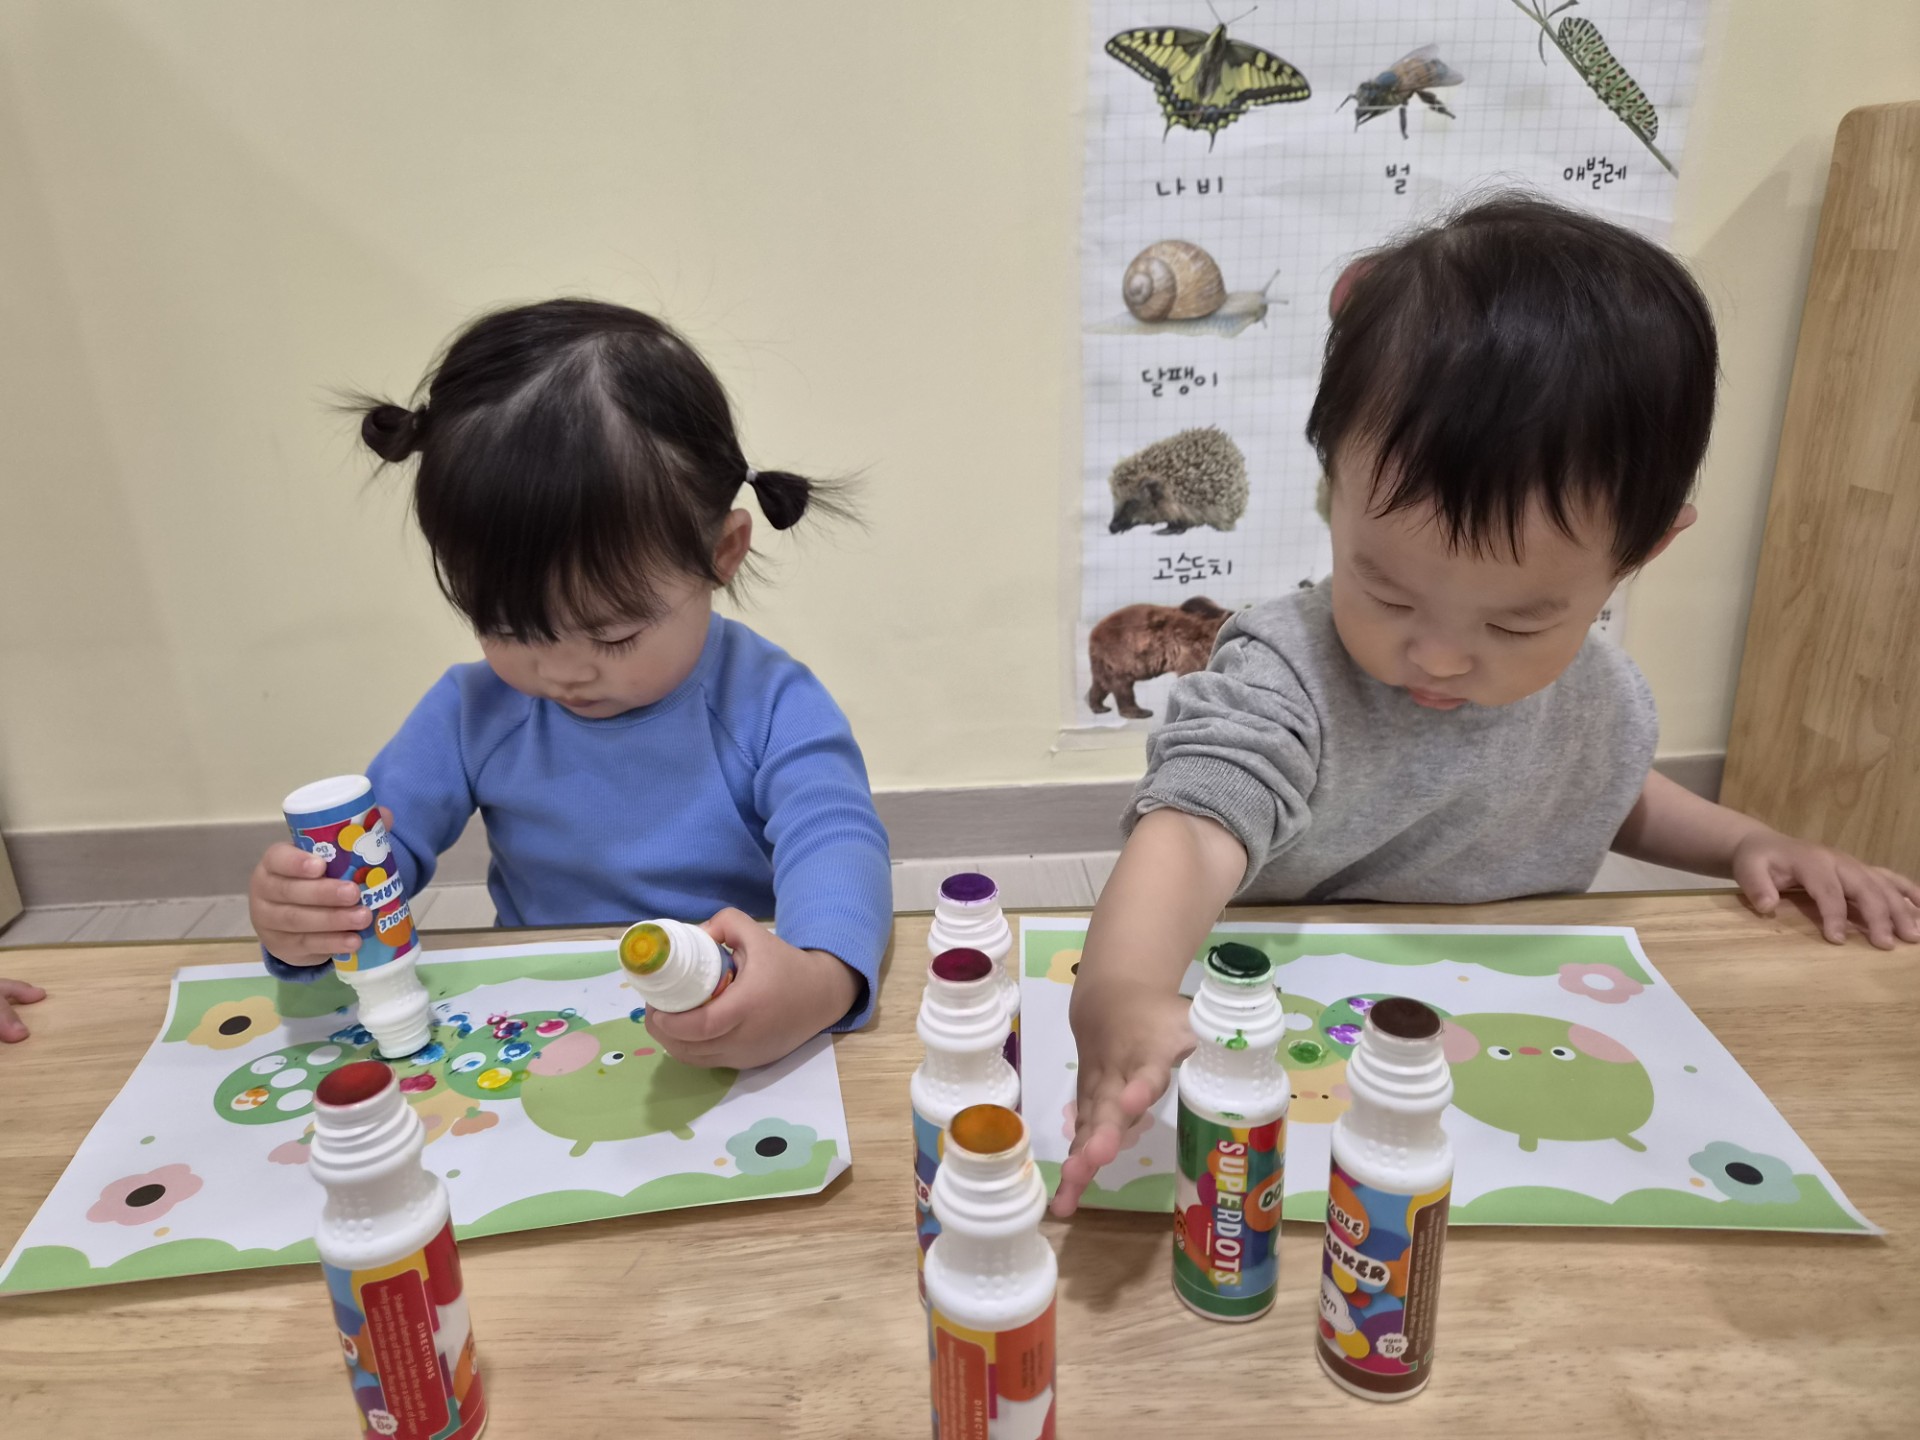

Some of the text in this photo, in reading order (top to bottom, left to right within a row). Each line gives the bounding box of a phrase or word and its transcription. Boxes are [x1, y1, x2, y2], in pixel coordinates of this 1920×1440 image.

[1156, 176, 1223, 196] 나비
[1386, 163, 1411, 195] 벌
[1563, 156, 1626, 190] 애벌레
[1141, 366, 1218, 397] 달팽이
[1152, 552, 1231, 584] 고슴도치
[363, 876, 403, 907] ARKE
[1260, 1183, 1283, 1209] DO
[1214, 1140, 1245, 1286] SUPERDOTS
[1329, 1199, 1362, 1237] ABLE
[1326, 1233, 1386, 1282] ARKER
[416, 1321, 435, 1380] DIRECTIONS
[974, 1399, 983, 1440] DIRECTI
